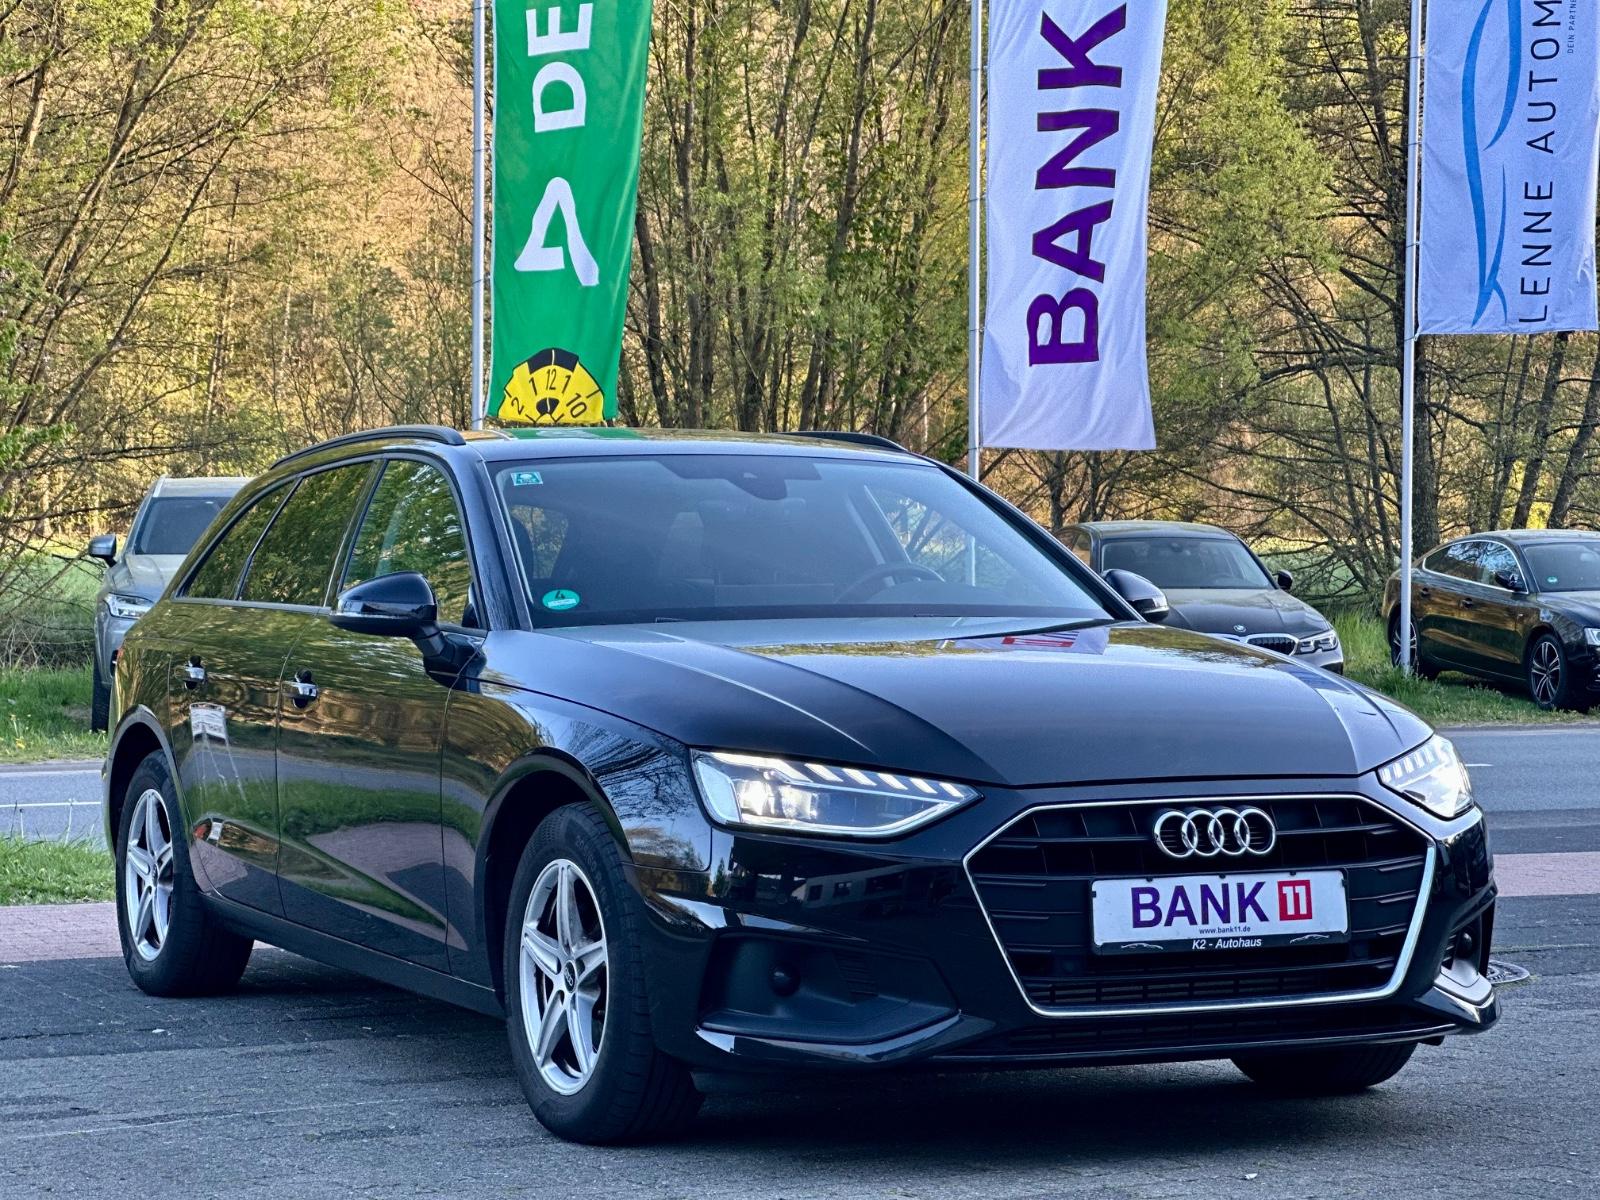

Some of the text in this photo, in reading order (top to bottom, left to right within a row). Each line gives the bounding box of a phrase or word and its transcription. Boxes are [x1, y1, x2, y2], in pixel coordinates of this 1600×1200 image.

[1567, 34, 1575, 54] DEIN
[1026, 3, 1127, 367] BANK
[1518, 0, 1562, 323] LENNE AUTOM
[511, 397, 525, 415] 2
[528, 377, 538, 396] 1
[546, 368, 557, 391] 12
[566, 392, 587, 419] 10
[1130, 881, 1309, 929] BANK 11
[1192, 939, 1207, 950] K2
[1215, 937, 1262, 949] Autohaus
[1199, 925, 1251, 934] www.bank11.de
